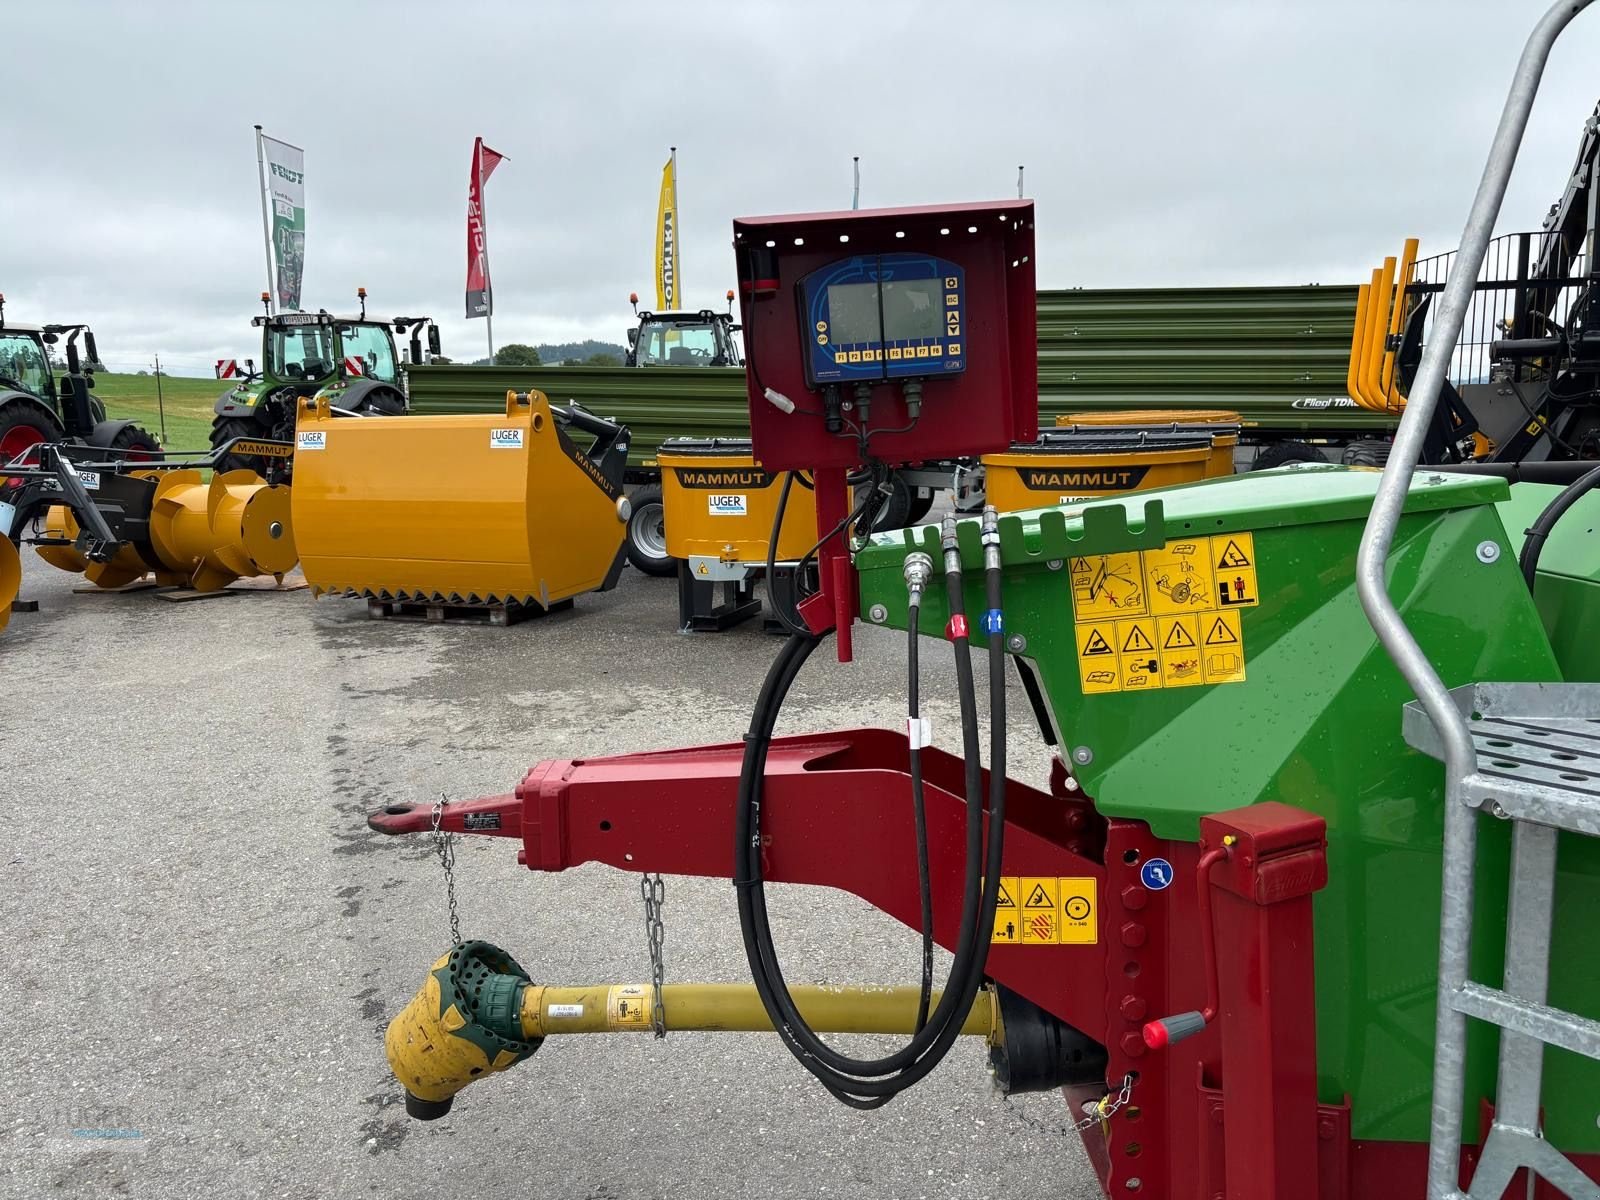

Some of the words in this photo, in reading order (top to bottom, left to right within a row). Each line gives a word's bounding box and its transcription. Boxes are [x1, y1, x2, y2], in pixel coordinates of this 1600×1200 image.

[270, 162, 304, 185] FENDT
[1303, 398, 1332, 408] Fliegl
[299, 433, 322, 442] LUGER
[491, 430, 519, 440] LUGER
[238, 444, 288, 455] MAMMUT
[575, 451, 615, 494] MAMMUT
[683, 473, 765, 485] MAMMUT
[1030, 472, 1131, 486] MAMMUT
[709, 496, 741, 507] LUGER
